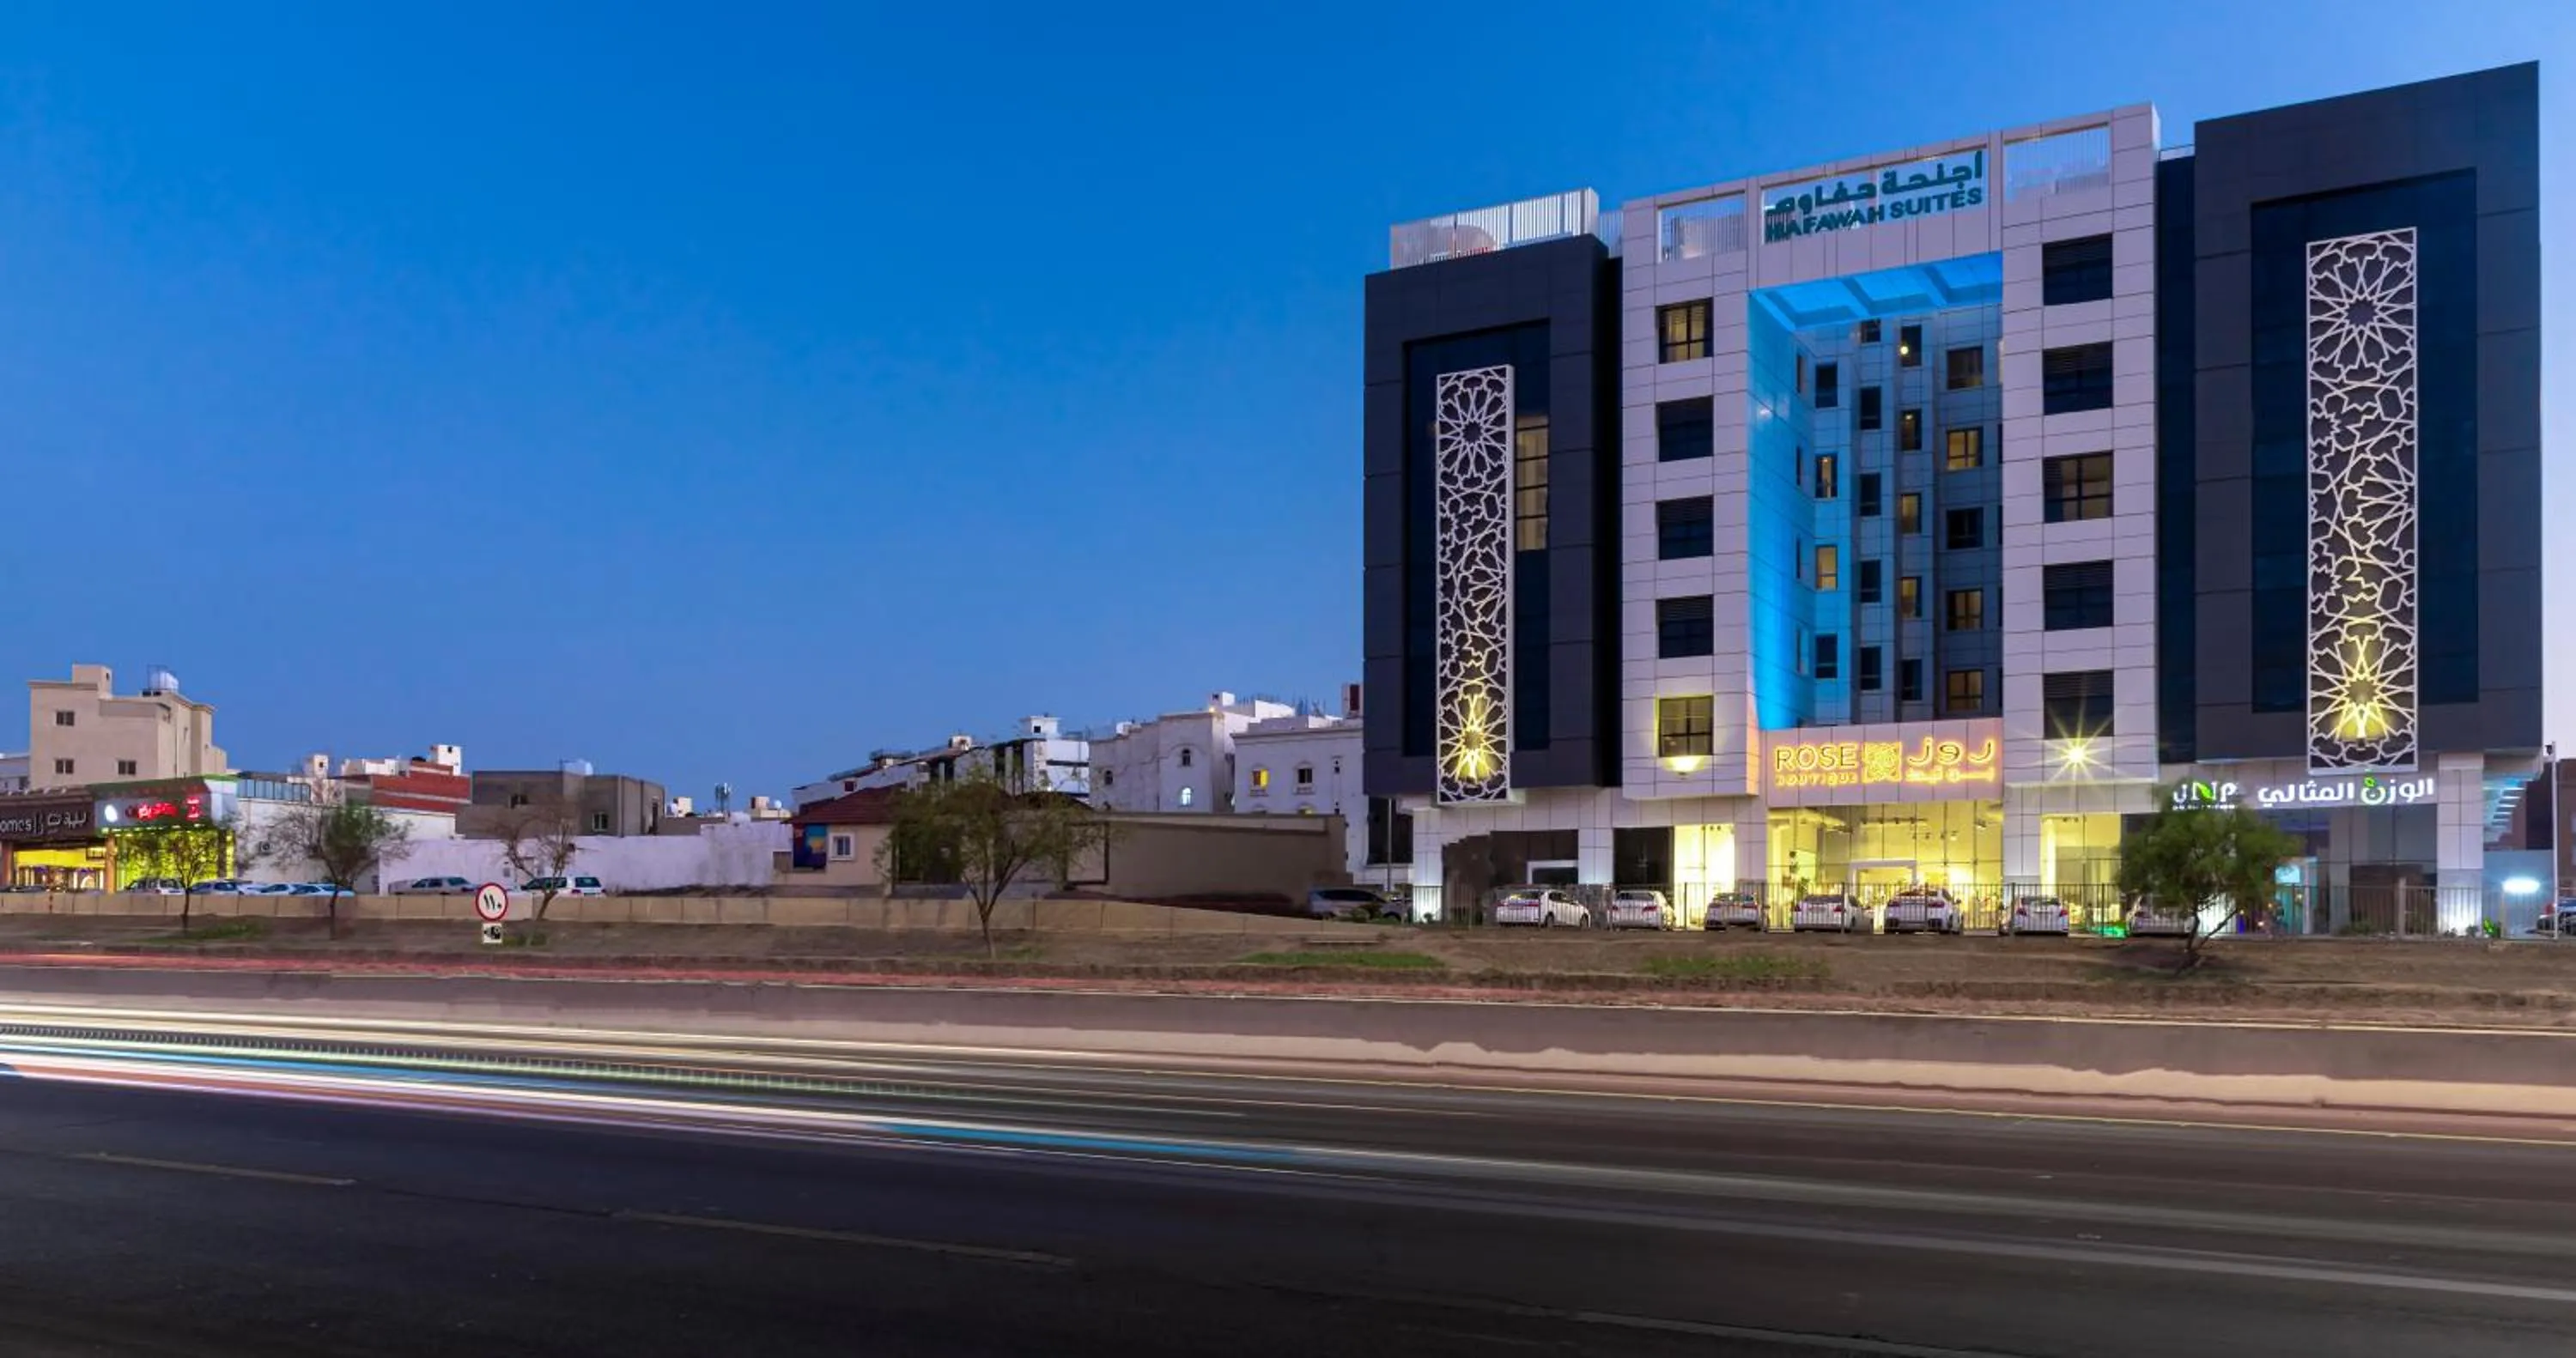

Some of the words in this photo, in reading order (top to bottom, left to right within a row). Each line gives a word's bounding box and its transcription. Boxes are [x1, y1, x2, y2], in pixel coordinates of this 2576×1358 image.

[1891, 187, 1983, 219] SUITES
[1775, 743, 1857, 772] ROSE
[1907, 737, 1995, 767] روز
[2257, 779, 2355, 808] المثالي
[2360, 774, 2434, 805] الوزن
